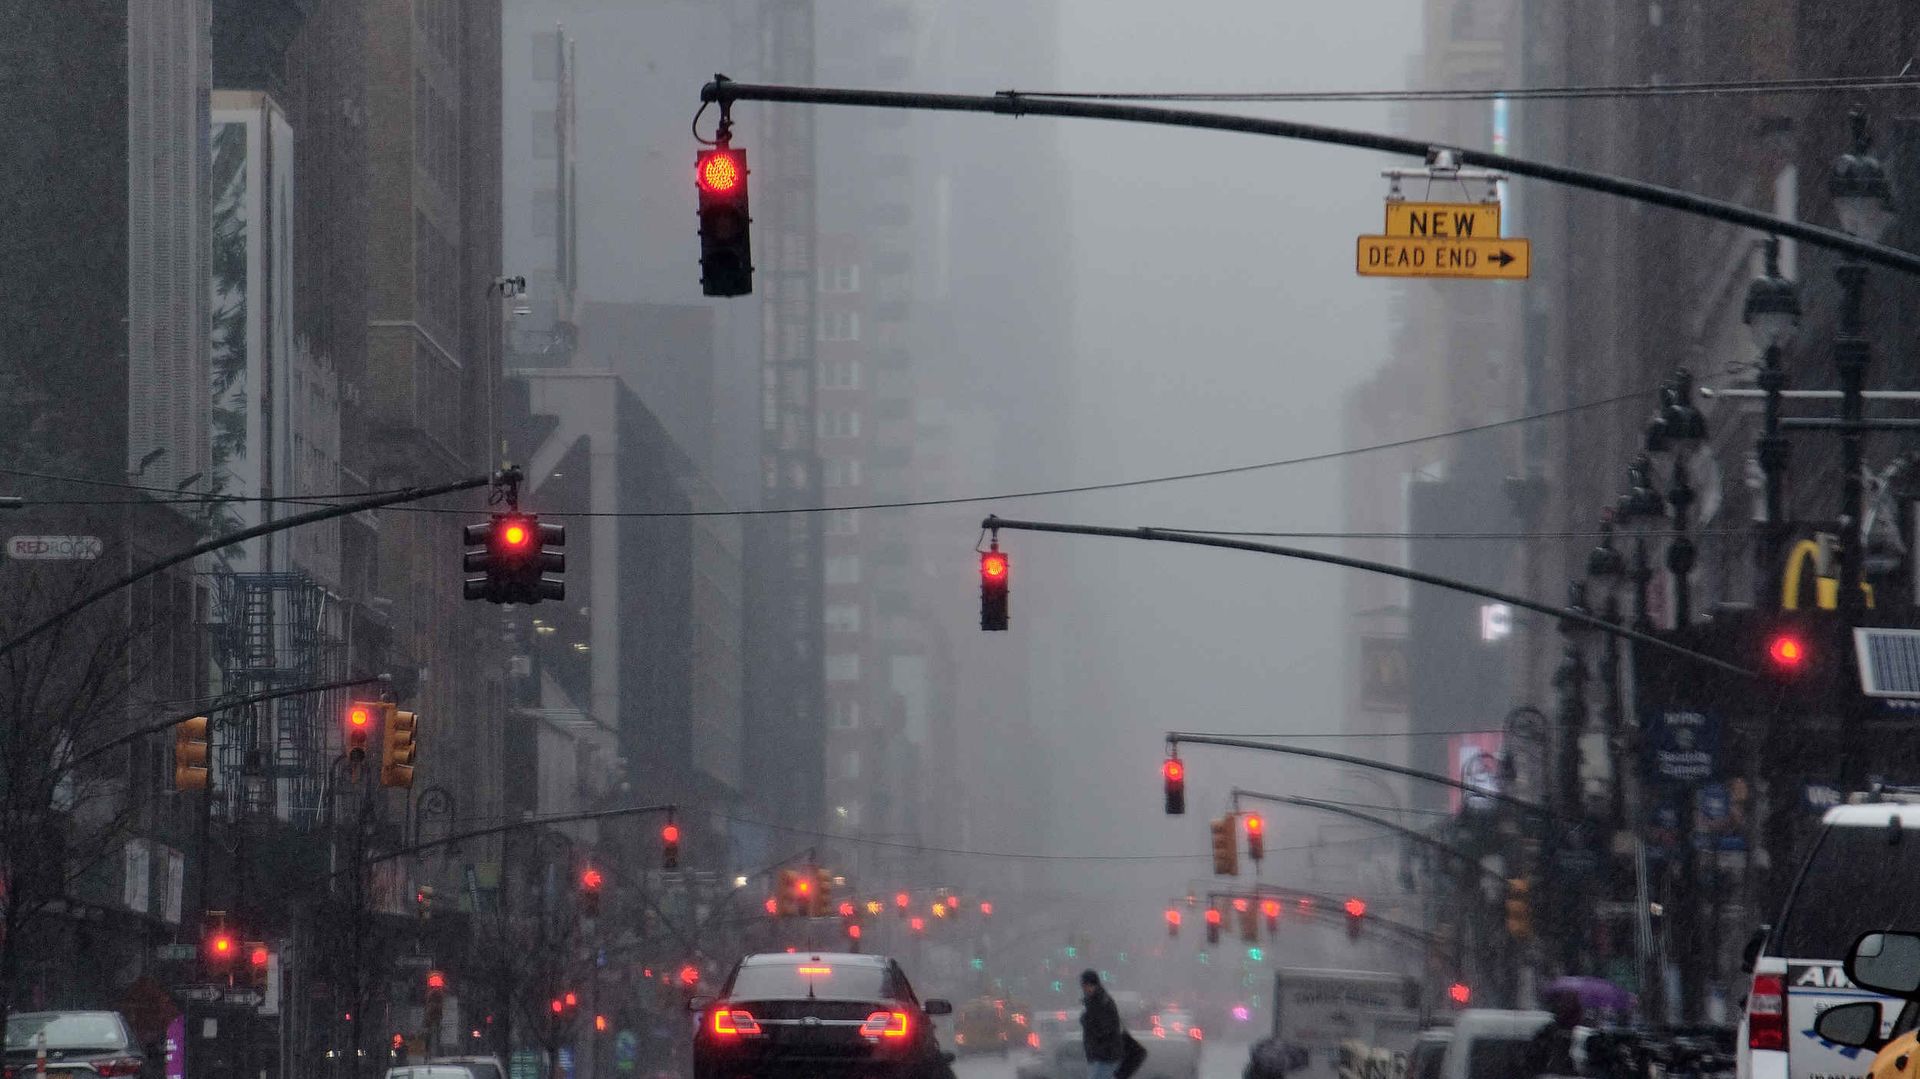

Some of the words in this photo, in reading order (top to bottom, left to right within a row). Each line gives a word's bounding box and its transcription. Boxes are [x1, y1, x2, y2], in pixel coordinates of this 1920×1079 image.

[1410, 211, 1475, 238] NEW
[1368, 246, 1425, 267] DEAD
[1436, 247, 1477, 268] END
